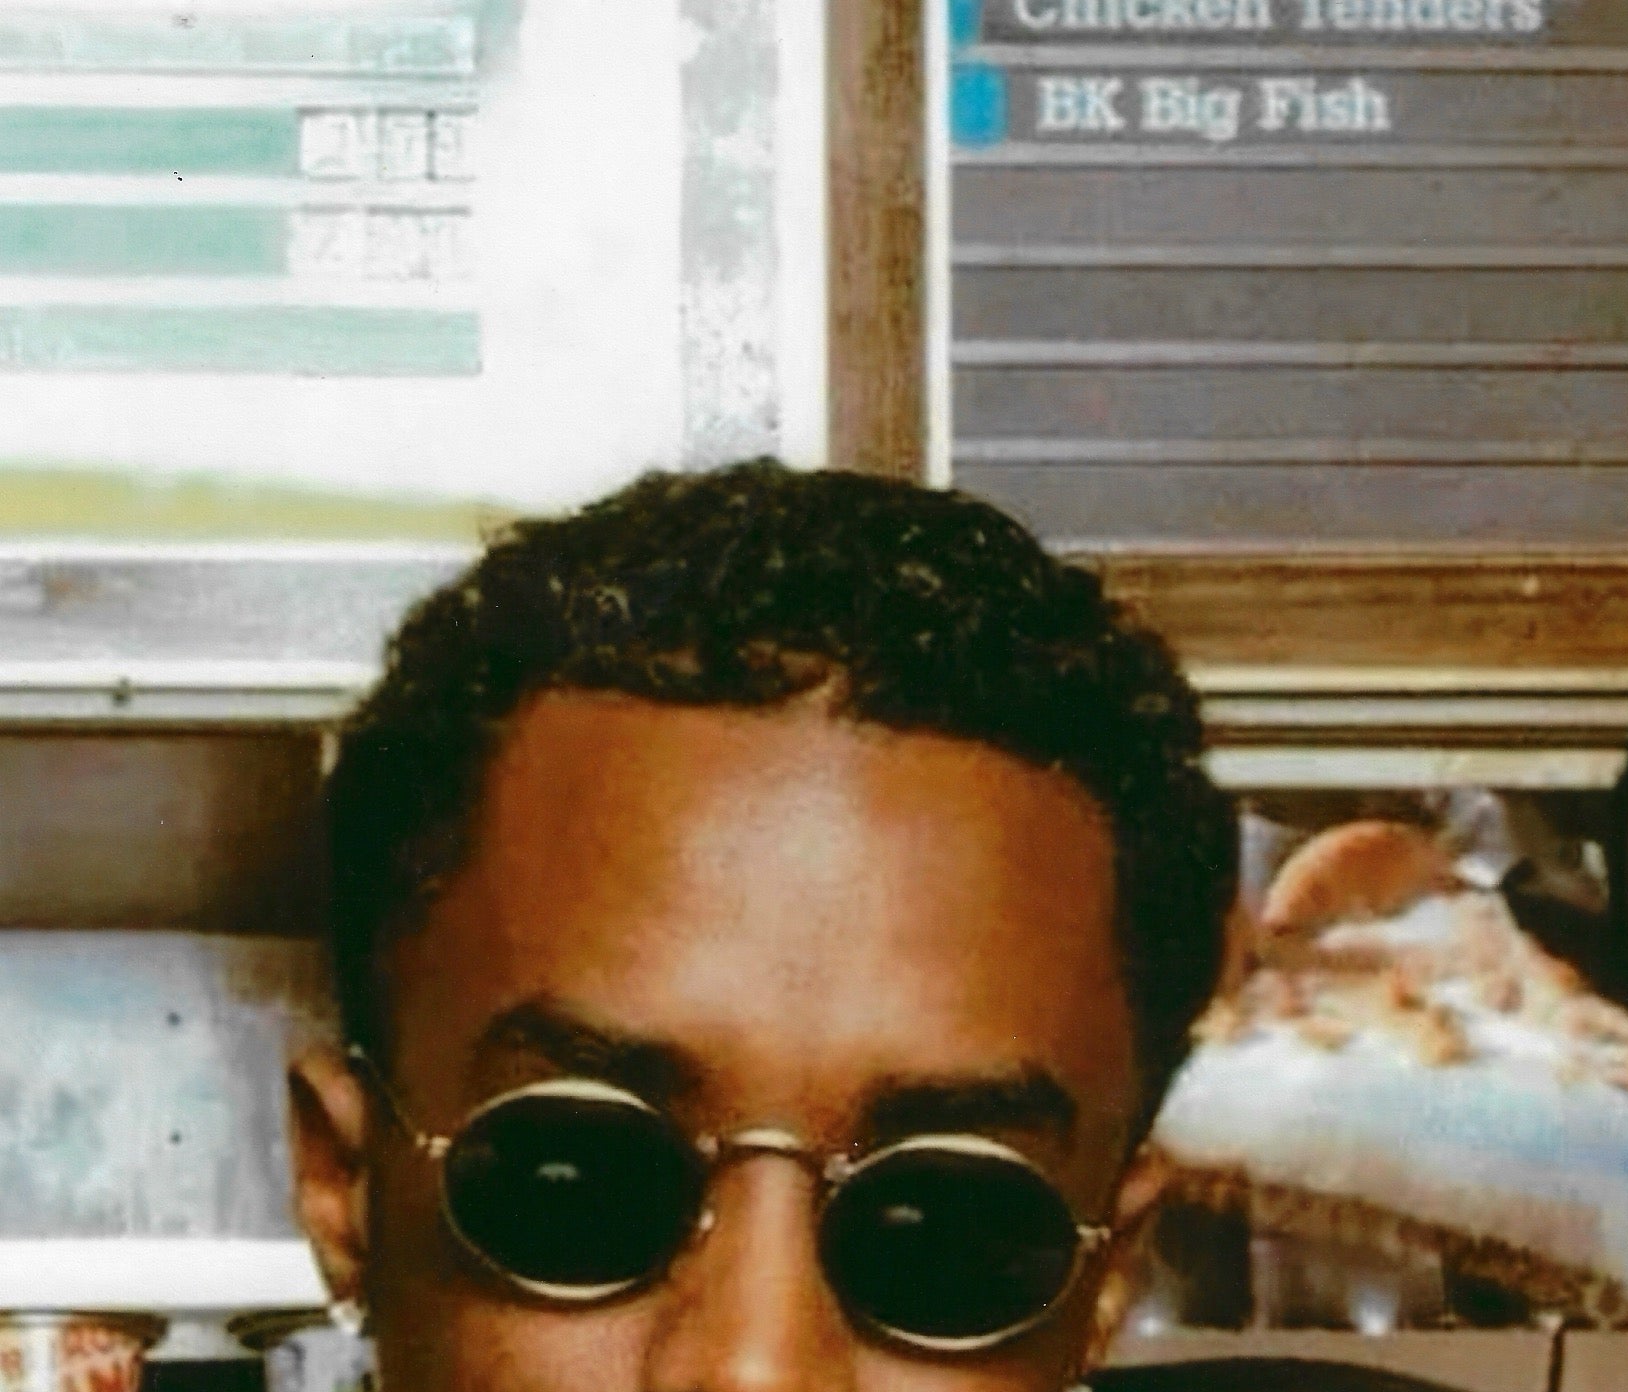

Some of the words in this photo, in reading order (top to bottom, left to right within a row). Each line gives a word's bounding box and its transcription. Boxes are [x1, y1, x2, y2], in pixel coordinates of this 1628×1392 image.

[1036, 75, 1126, 132] BK
[1138, 75, 1243, 142] Big
[1256, 75, 1391, 132] Fish
